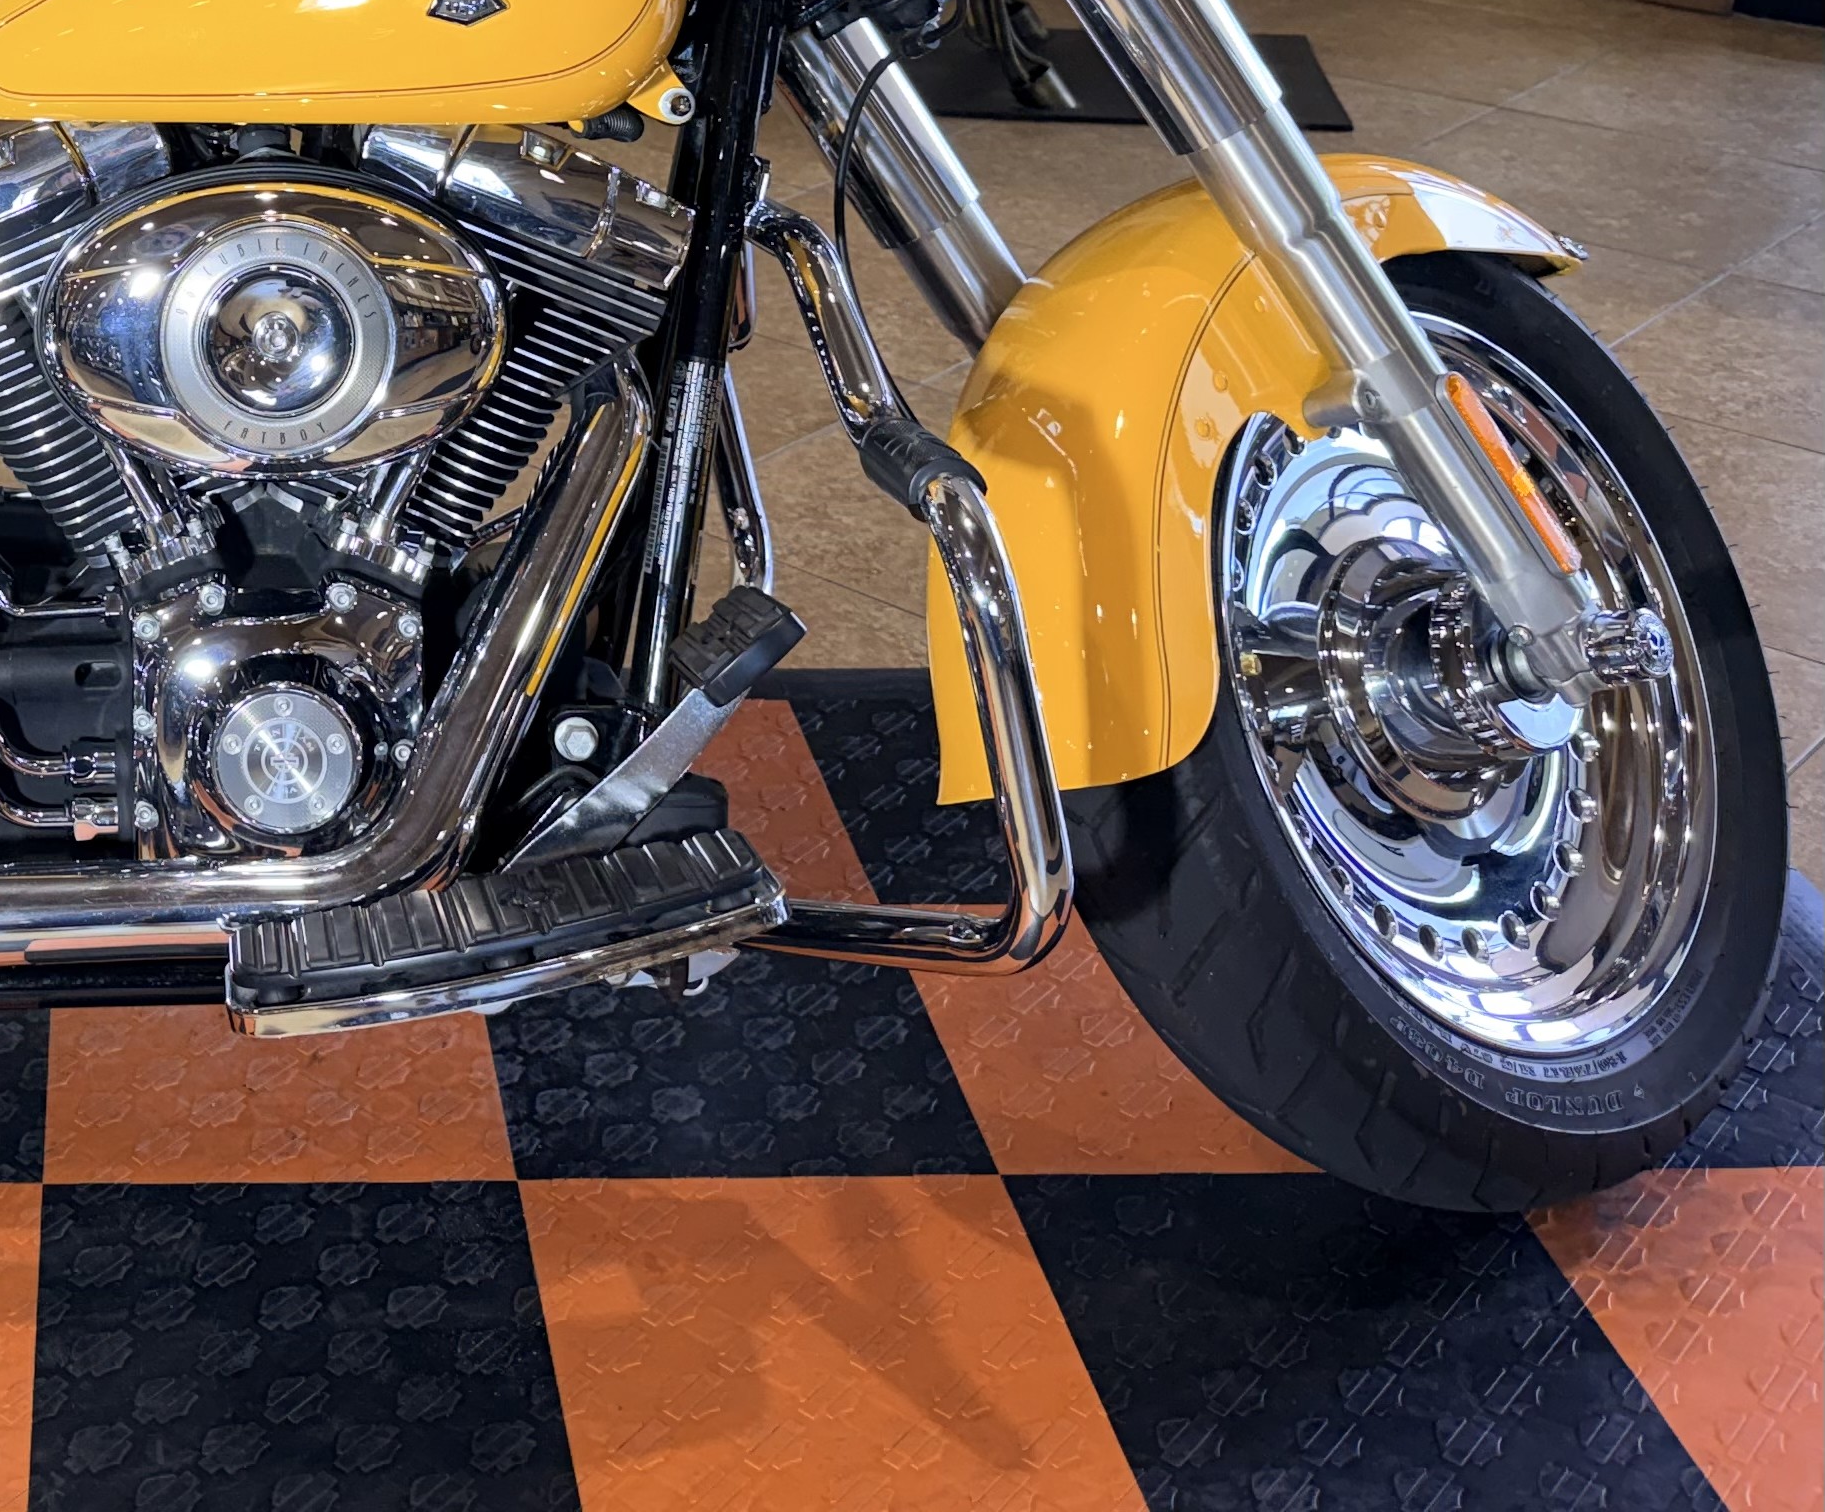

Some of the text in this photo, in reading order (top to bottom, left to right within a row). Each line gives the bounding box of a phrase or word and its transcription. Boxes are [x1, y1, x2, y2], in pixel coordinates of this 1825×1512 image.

[203, 237, 282, 277] CUBIC
[302, 241, 378, 321] INCHES
[1505, 1088, 1624, 1115] DUNLOP
